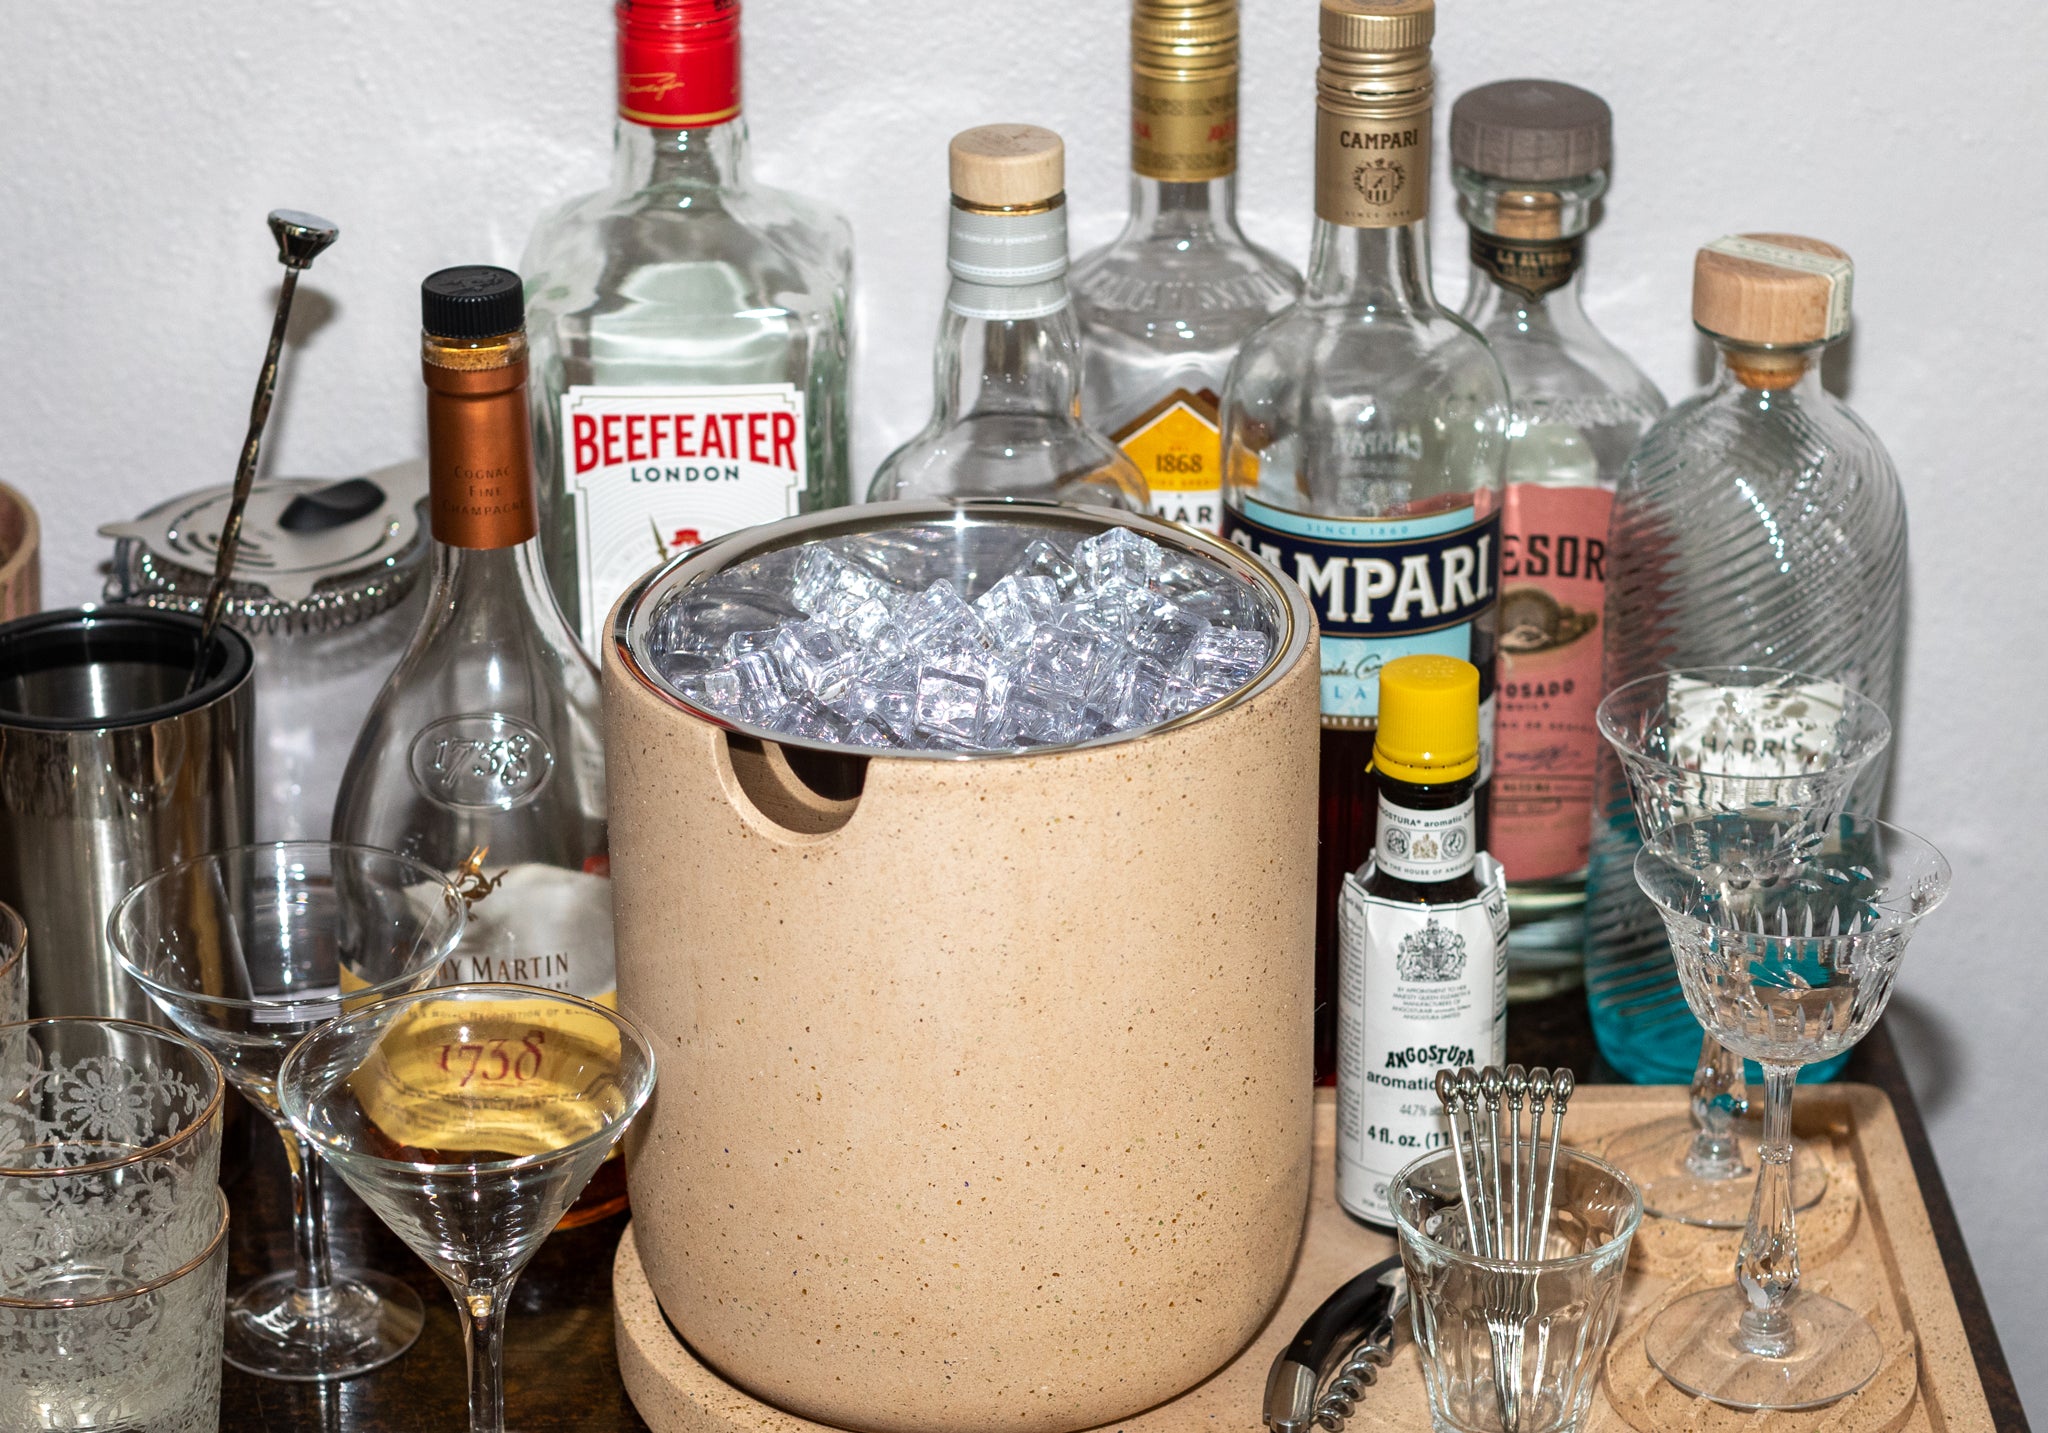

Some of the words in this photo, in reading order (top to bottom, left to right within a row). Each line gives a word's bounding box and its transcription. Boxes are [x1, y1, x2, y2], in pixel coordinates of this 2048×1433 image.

[1340, 129, 1418, 149] CAMPARI
[573, 411, 798, 475] BEEFEATER
[631, 466, 740, 482] LONDON
[1156, 454, 1203, 473] 1868
[1306, 523, 1357, 536] SINCE
[1369, 525, 1409, 535] 1860
[434, 735, 530, 788] 1738
[1424, 815, 1462, 827] aromatic
[472, 952, 568, 981] MARTIN
[438, 1030, 545, 1087] 1738
[1385, 1045, 1475, 1068] ANGOSTURA
[1367, 1071, 1437, 1091] aromatic
[1368, 1125, 1376, 1140] 4
[1380, 1126, 1394, 1144] fl.
[1399, 1135, 1421, 1147] oz.
[1425, 1132, 1450, 1149] (11
